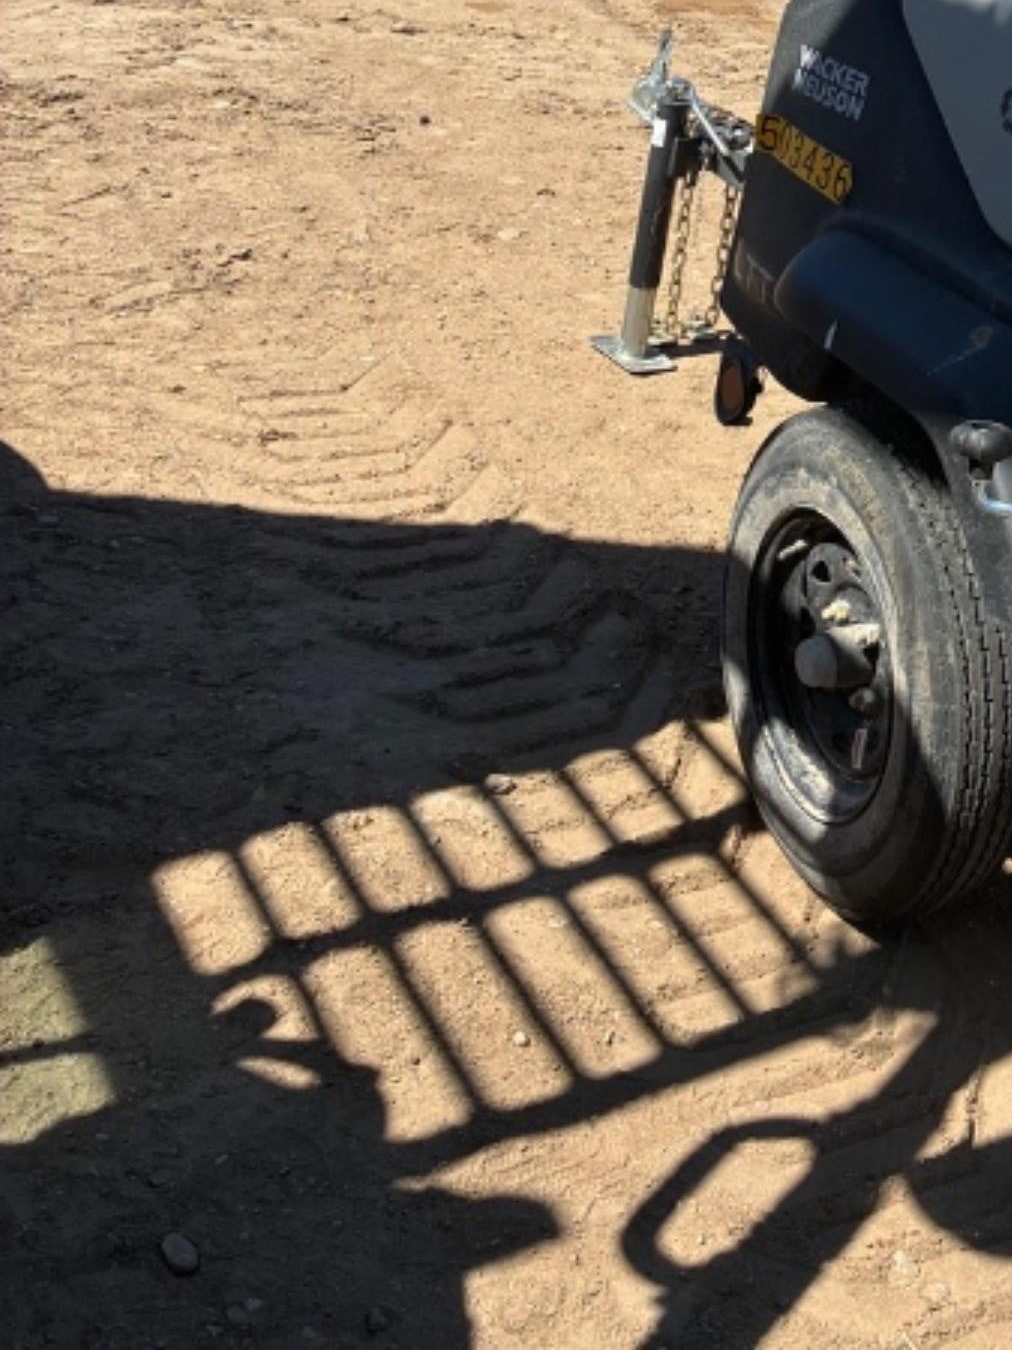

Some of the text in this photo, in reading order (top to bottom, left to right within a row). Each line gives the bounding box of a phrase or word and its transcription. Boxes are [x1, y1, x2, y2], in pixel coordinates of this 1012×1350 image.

[793, 68, 865, 121] NEUSON
[800, 44, 870, 97] WACKER
[761, 116, 850, 199] 503436
